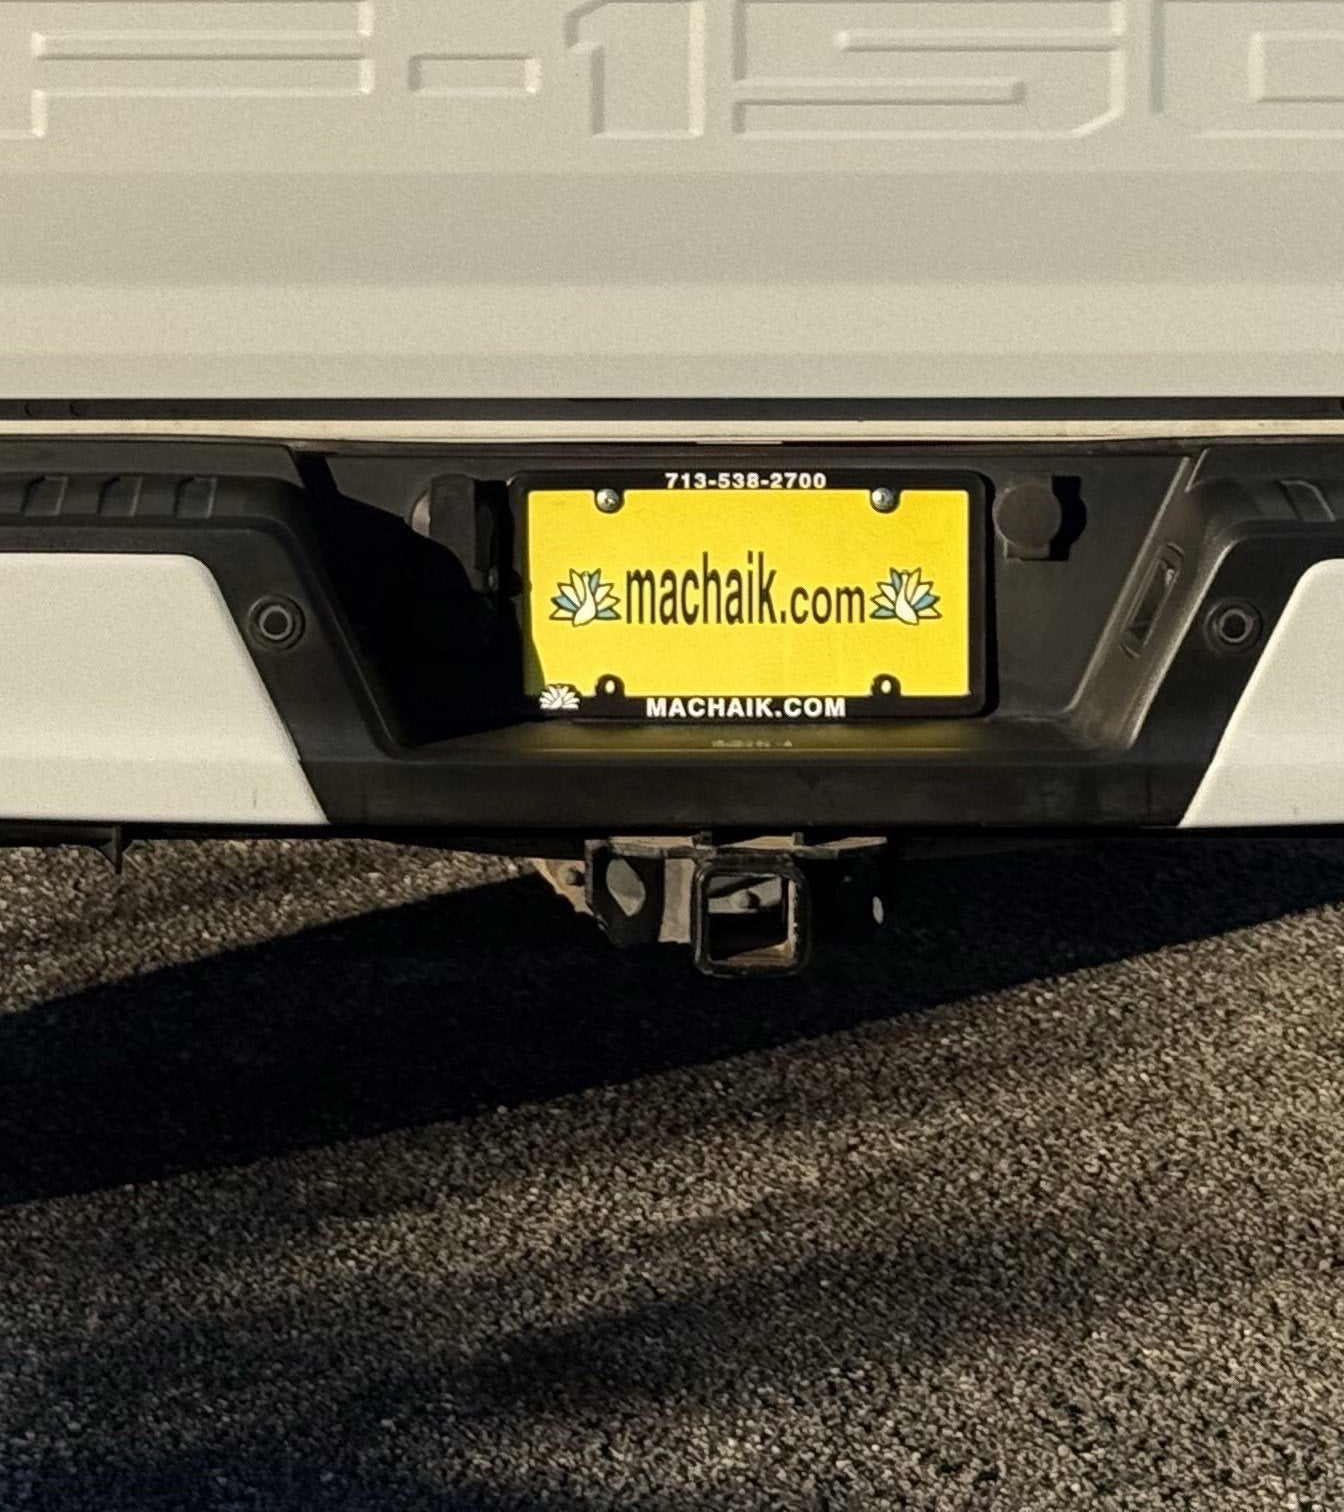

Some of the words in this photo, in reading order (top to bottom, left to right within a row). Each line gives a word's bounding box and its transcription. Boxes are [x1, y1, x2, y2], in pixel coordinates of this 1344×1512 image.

[664, 472, 827, 489] 713-538-2700
[625, 550, 866, 625] machaik.com
[645, 698, 847, 718] MACHAIK.COM
